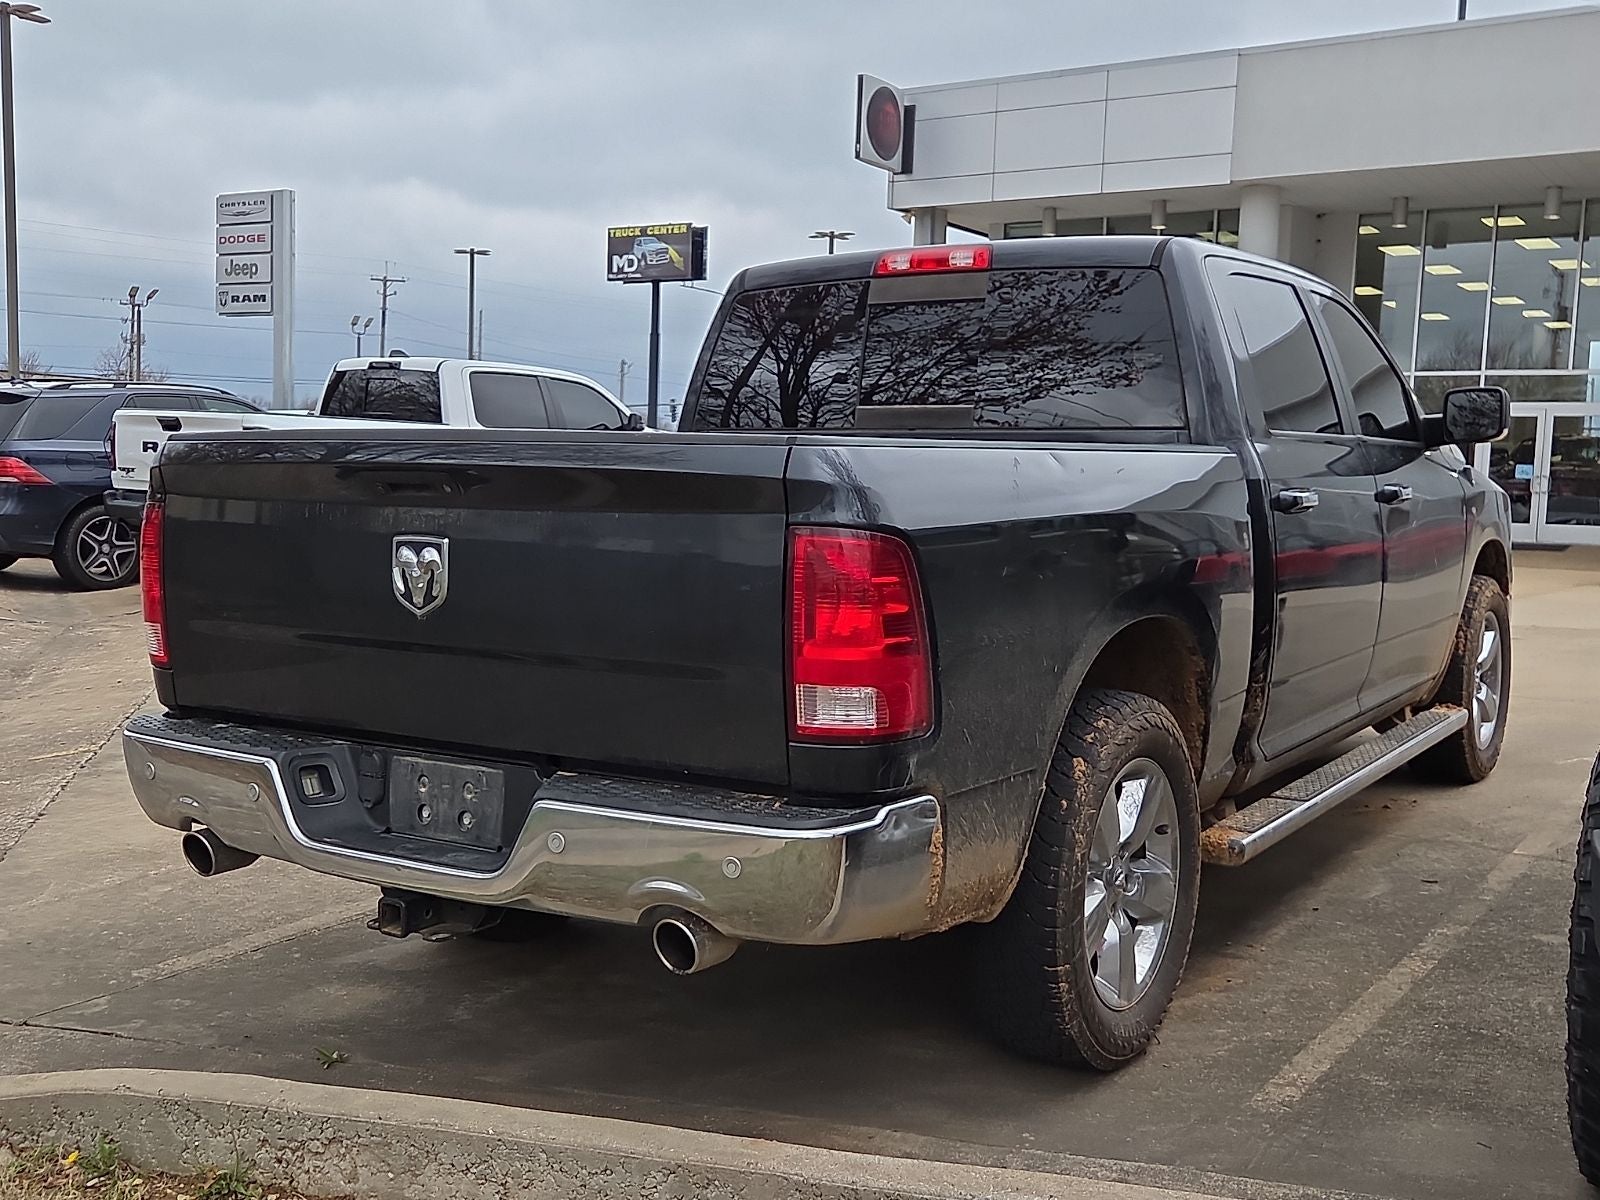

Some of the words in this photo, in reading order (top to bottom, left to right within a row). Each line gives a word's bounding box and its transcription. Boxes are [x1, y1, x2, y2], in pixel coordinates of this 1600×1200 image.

[219, 200, 265, 208] CHRYSLER
[610, 228, 641, 238] TRUCK
[646, 224, 687, 235] CENTER
[219, 234, 266, 245] DODGE
[224, 259, 259, 279] Jeep
[612, 254, 638, 273] MD
[231, 294, 267, 303] RAM
